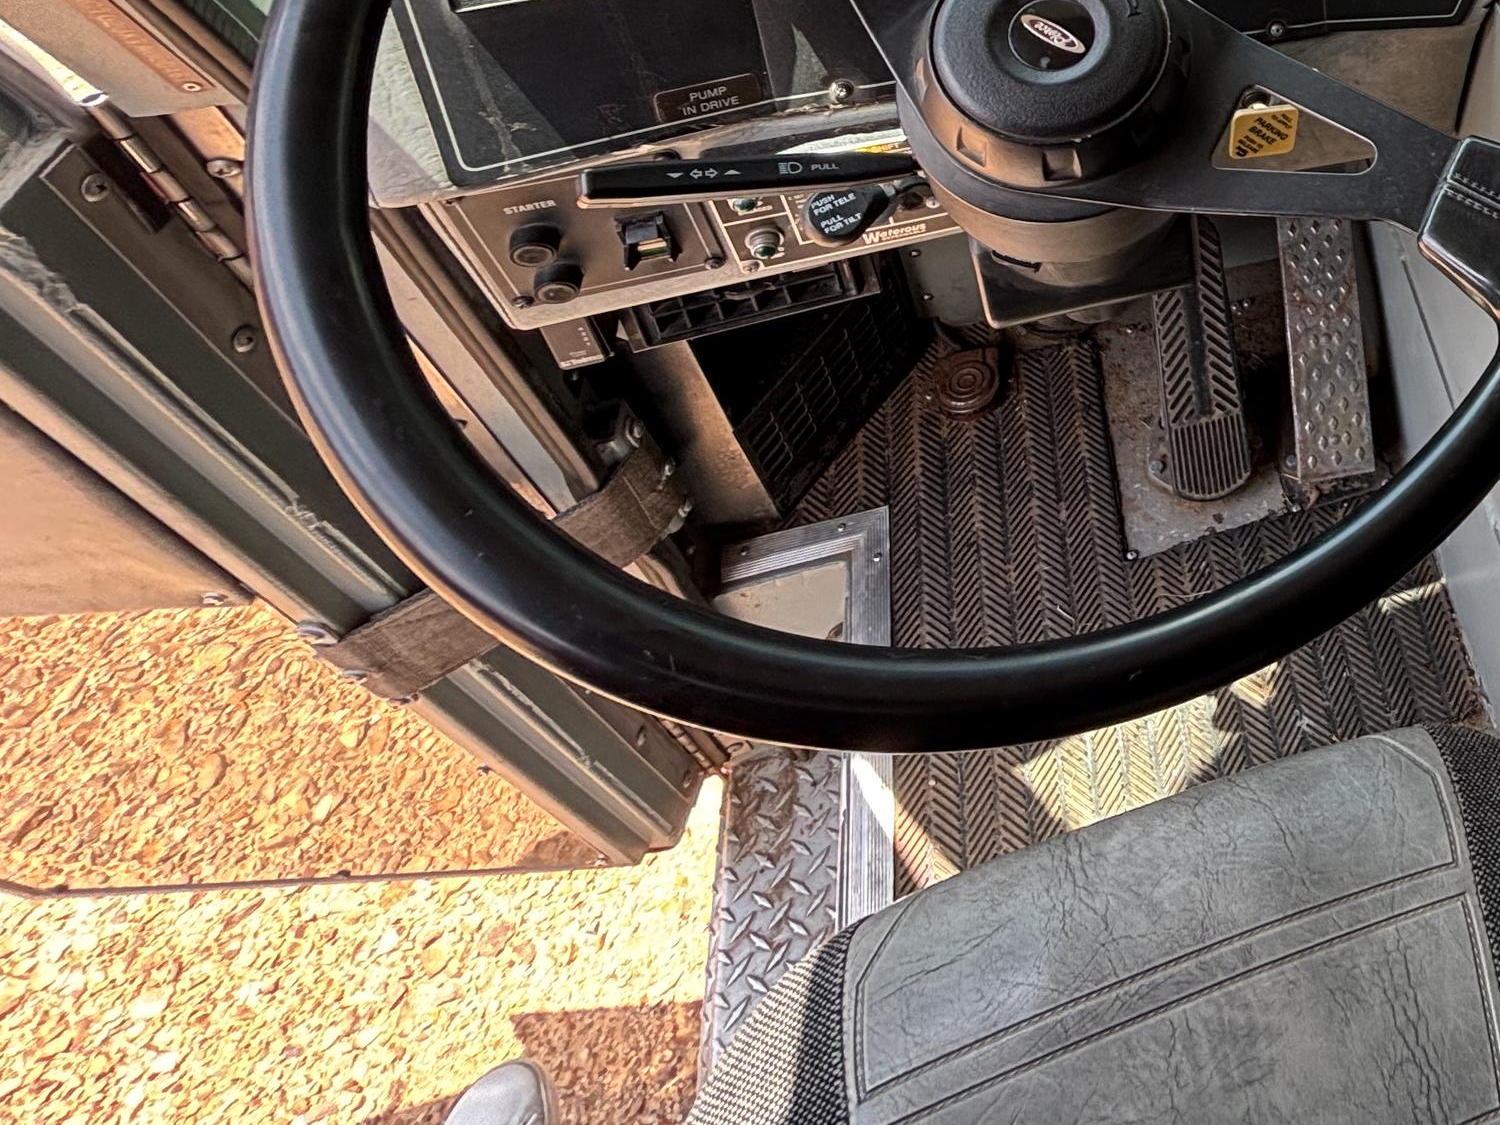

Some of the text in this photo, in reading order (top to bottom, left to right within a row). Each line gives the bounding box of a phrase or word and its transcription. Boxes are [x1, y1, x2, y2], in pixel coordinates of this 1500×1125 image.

[689, 86, 727, 102] PUMP
[682, 96, 740, 116] IN DRIVE
[1248, 126, 1277, 145] BRAKE
[1254, 117, 1289, 141] PARKING
[811, 163, 839, 171] PULL
[503, 200, 557, 215] STARTER
[811, 194, 835, 209] PUSH
[813, 193, 857, 216] FOR TELE
[820, 215, 844, 228] PULL
[824, 213, 861, 234] FOR TILT
[862, 223, 927, 244] Waterous
